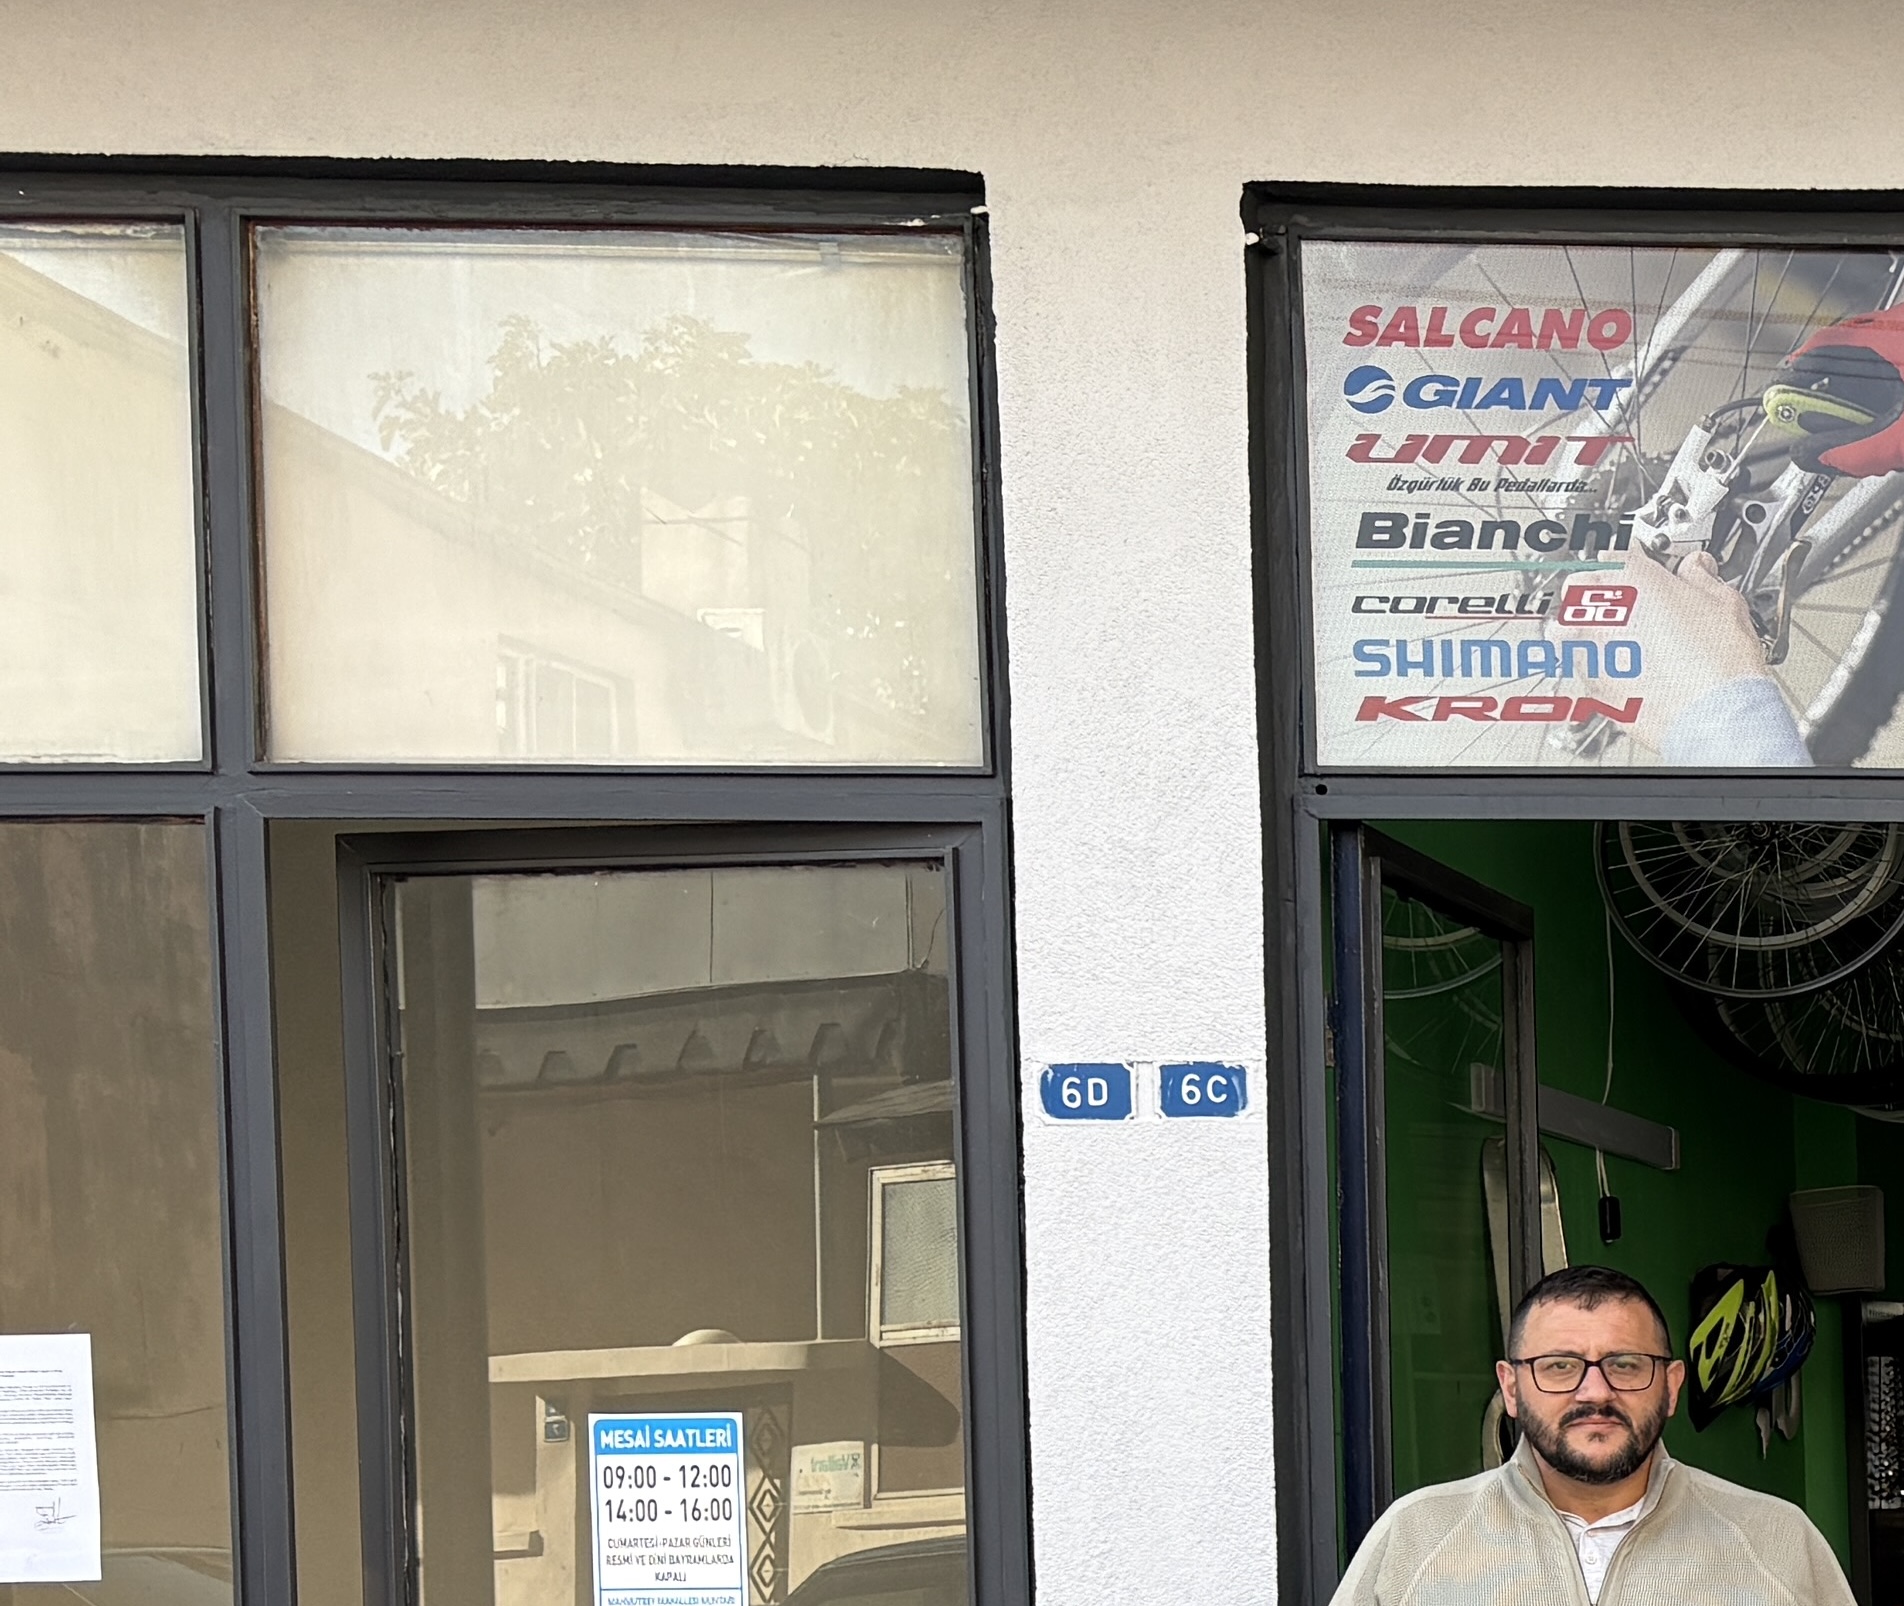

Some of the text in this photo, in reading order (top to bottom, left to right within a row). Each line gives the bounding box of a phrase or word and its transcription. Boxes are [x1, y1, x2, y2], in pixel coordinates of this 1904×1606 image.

[1342, 305, 1632, 350] SALCANO
[1403, 376, 1633, 411] GIANT
[1386, 474, 1466, 494] Özgürlük
[1467, 478, 1490, 493] Bu
[1355, 512, 1634, 552] Bianchi
[1351, 592, 1553, 616] corelli
[1354, 639, 1642, 678] SHIMANO
[1355, 696, 1643, 722] KRON
[1062, 1076, 1108, 1108] 6D
[1181, 1074, 1228, 1105] 6C
[601, 1423, 731, 1449] MESAİ SAATLERİ
[603, 1465, 656, 1489] 09:00
[679, 1464, 731, 1488] 12:00
[605, 1499, 658, 1522] 14:00
[680, 1498, 732, 1522] 16:00
